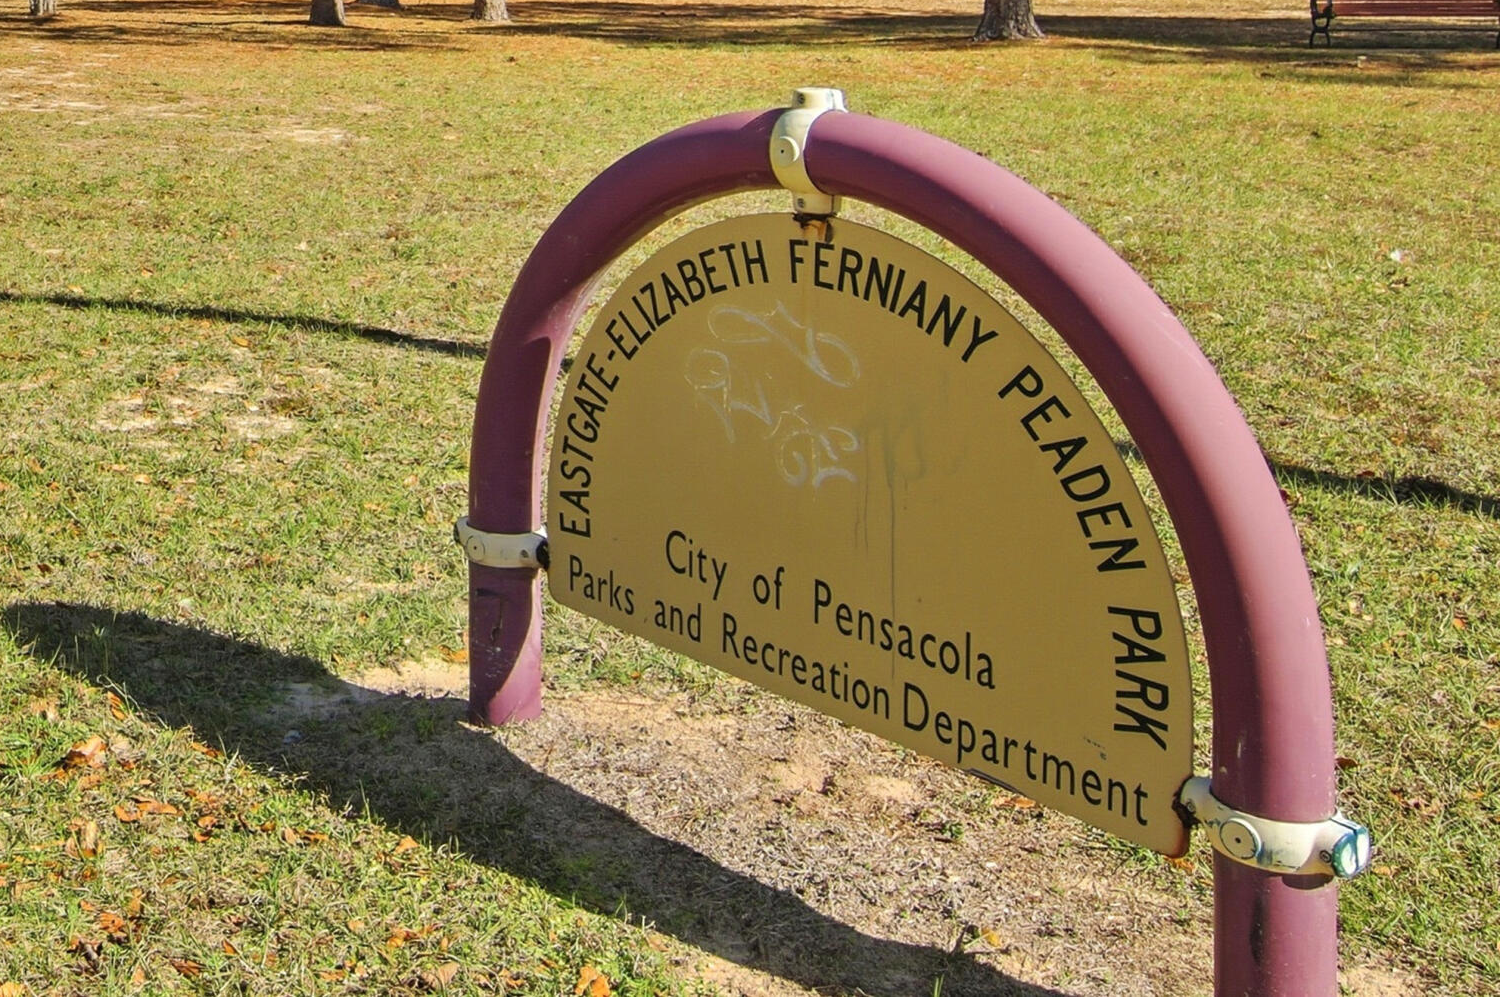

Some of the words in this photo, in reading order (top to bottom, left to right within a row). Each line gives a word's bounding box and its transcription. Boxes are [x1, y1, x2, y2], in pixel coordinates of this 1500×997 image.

[559, 239, 769, 539] EASTGATE-ELIZABETH
[788, 238, 1000, 364] FERNIANY
[997, 364, 1147, 573] PEADEN
[1107, 605, 1170, 752] PARK
[665, 530, 728, 601] City
[752, 566, 786, 610] of
[813, 578, 997, 690] Pensacola
[569, 554, 635, 616] Parks
[654, 600, 702, 643] and
[722, 612, 891, 720] Recreation
[902, 681, 1150, 827] Department
